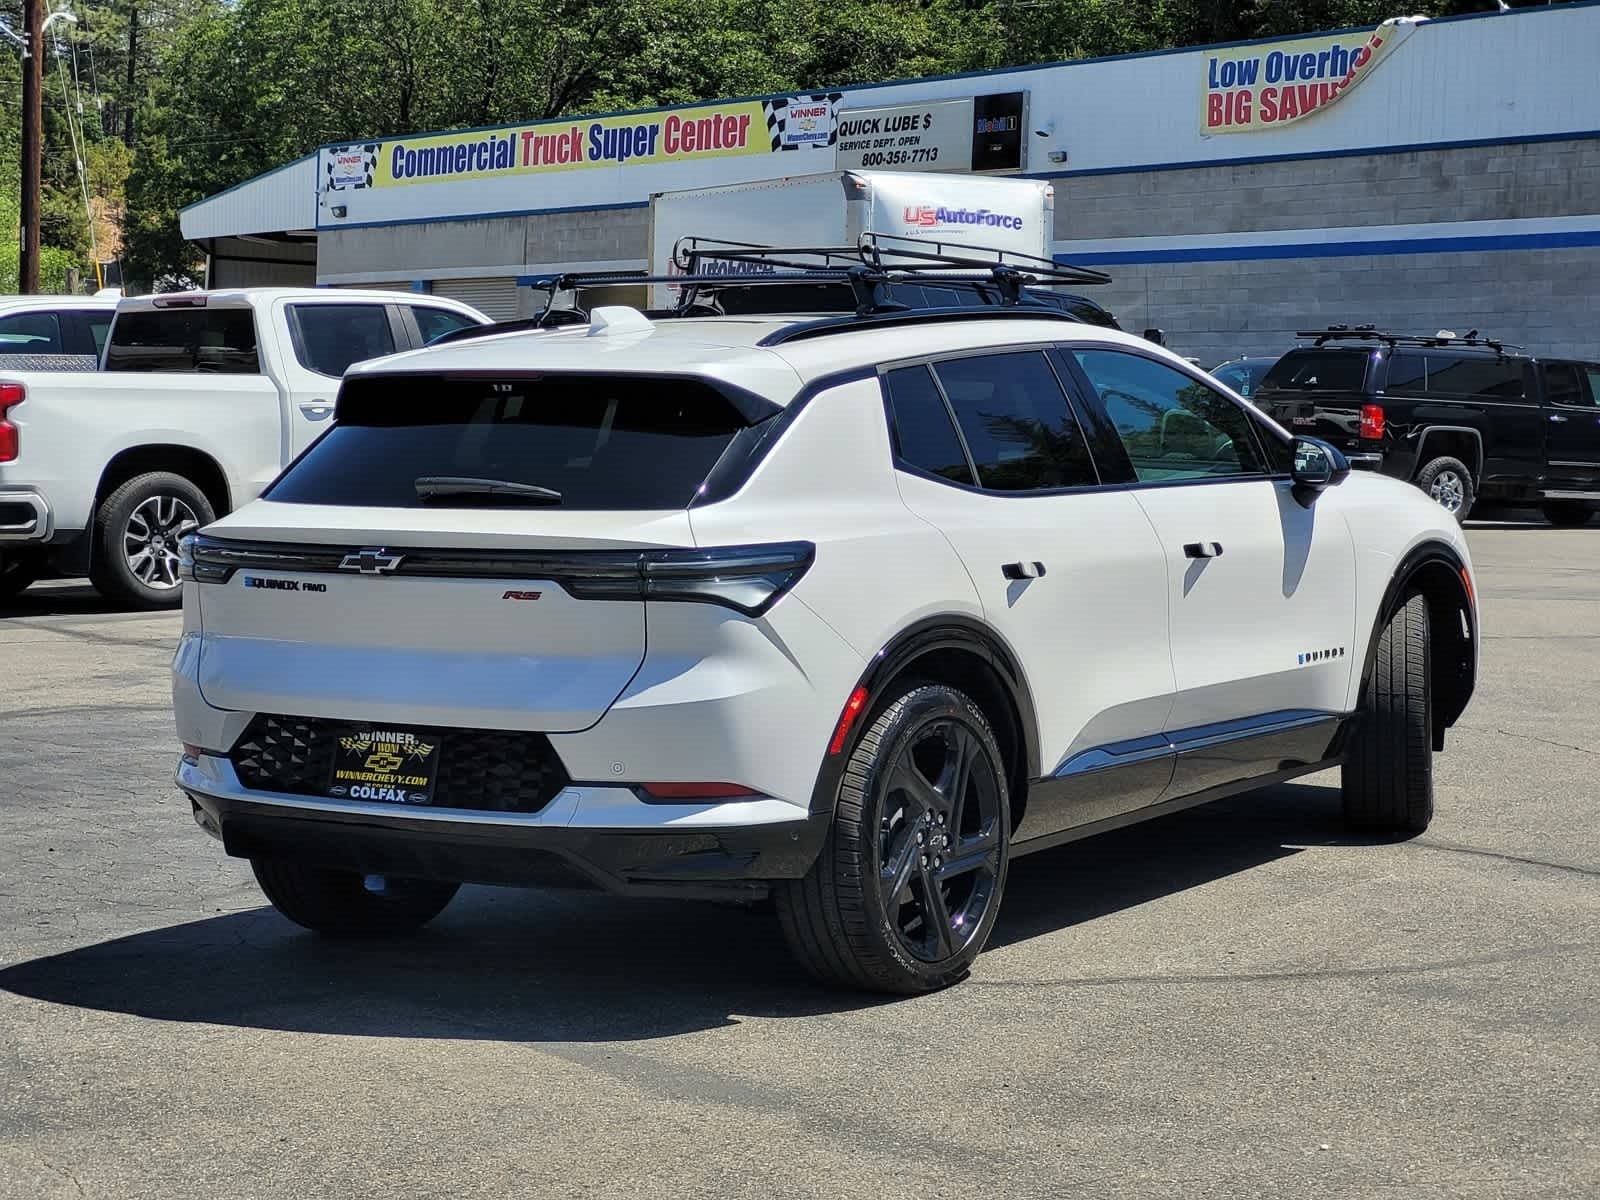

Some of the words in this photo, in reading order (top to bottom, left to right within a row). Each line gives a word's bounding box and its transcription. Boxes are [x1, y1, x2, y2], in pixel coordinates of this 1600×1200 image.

[1208, 57, 1260, 89] Low
[790, 107, 826, 119] WINNER
[1207, 90, 1252, 127] BIG
[839, 119, 881, 136] QUICK
[884, 115, 920, 132] LUBE
[923, 113, 932, 130] $
[391, 133, 516, 179] Commercial
[521, 127, 584, 166] Truck
[588, 124, 660, 162] Super
[664, 114, 750, 154] Center
[839, 140, 871, 151] SERVICE
[873, 138, 896, 148] DEPT.
[898, 136, 921, 146] OPEN
[244, 576, 300, 591] EQUINOX
[502, 591, 542, 600] RS
[1298, 646, 1345, 665] EQUINOX
[359, 731, 415, 745] WINNER
[336, 770, 428, 786] WINNERCHEVY.COM
[350, 785, 406, 802] COLFAX
